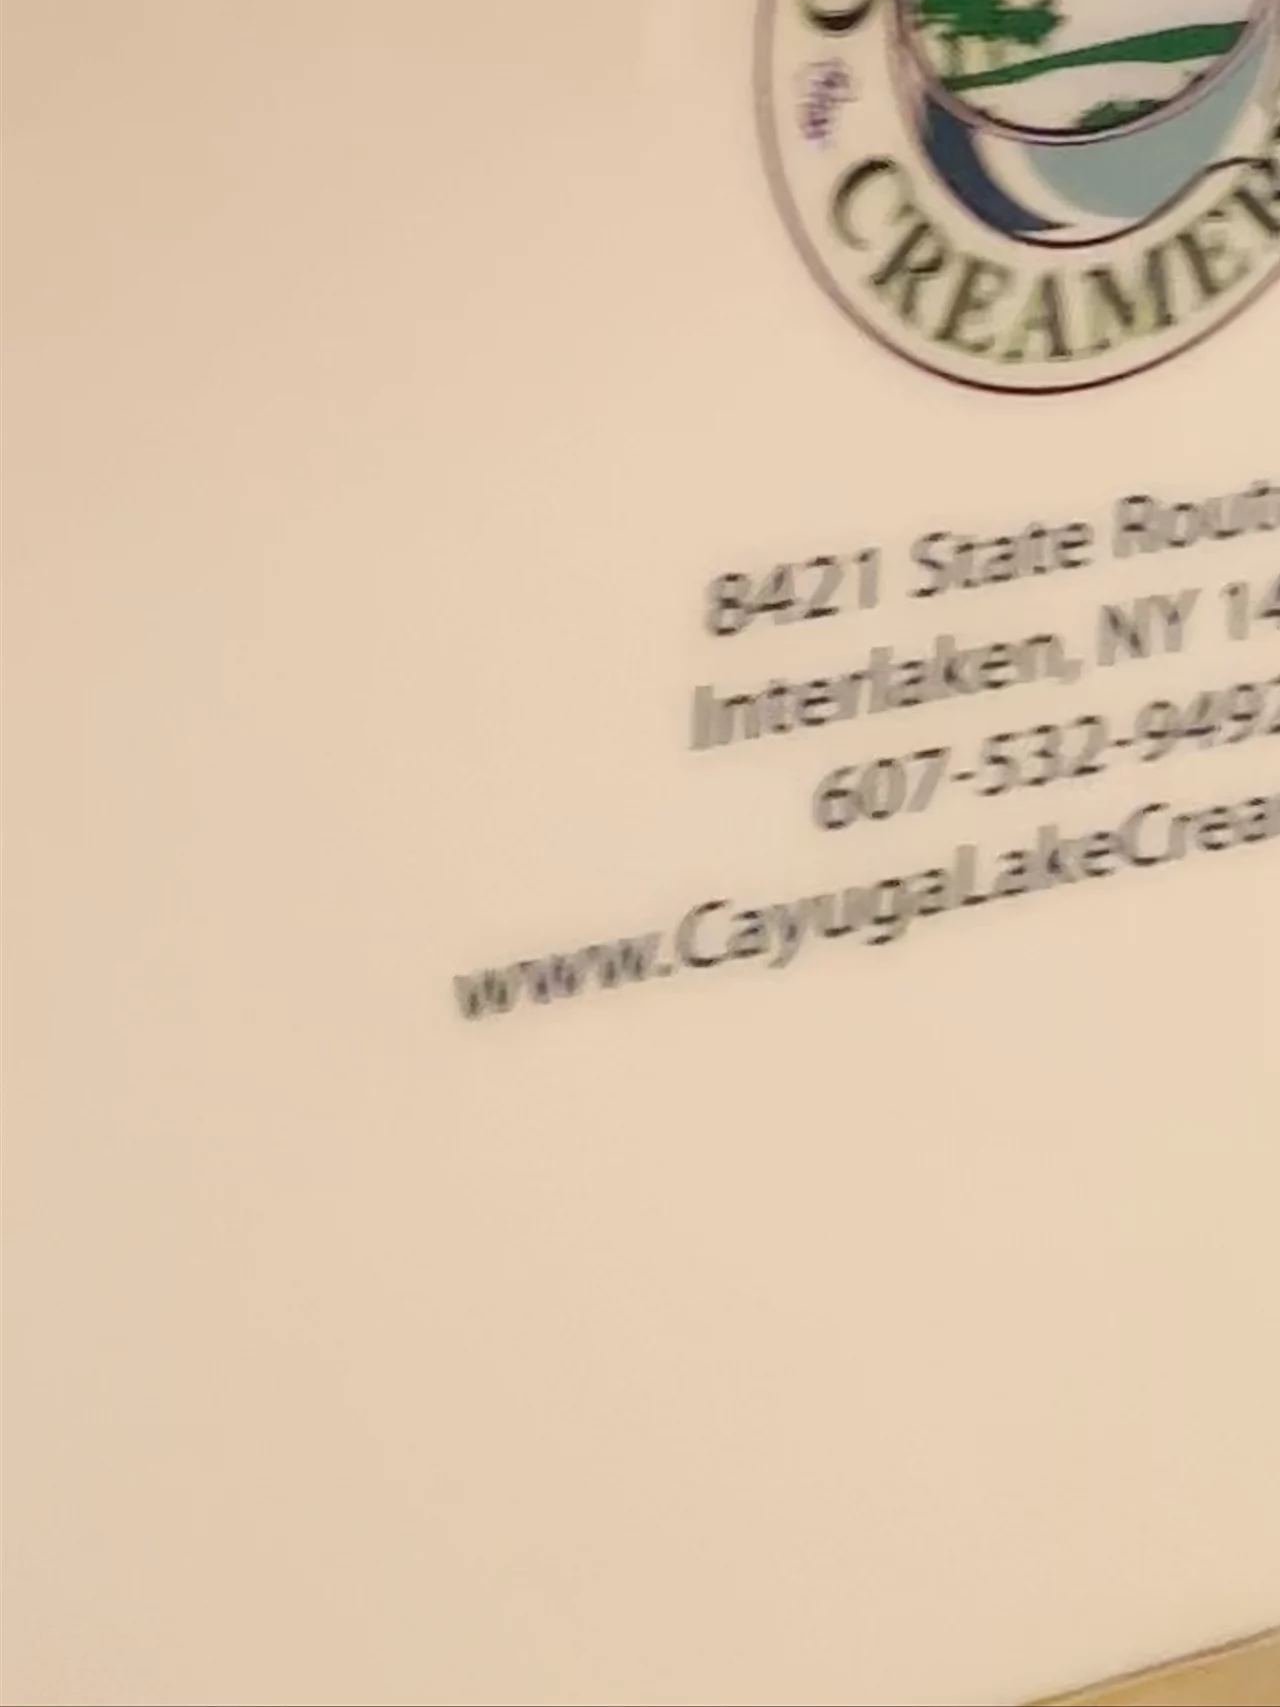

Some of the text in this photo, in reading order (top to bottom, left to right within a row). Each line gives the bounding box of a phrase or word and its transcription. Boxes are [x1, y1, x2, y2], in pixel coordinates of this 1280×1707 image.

[704, 545, 882, 638] 8421
[908, 515, 1095, 601] State
[689, 627, 1083, 753] Interlaken,
[1097, 588, 1200, 670] NY
